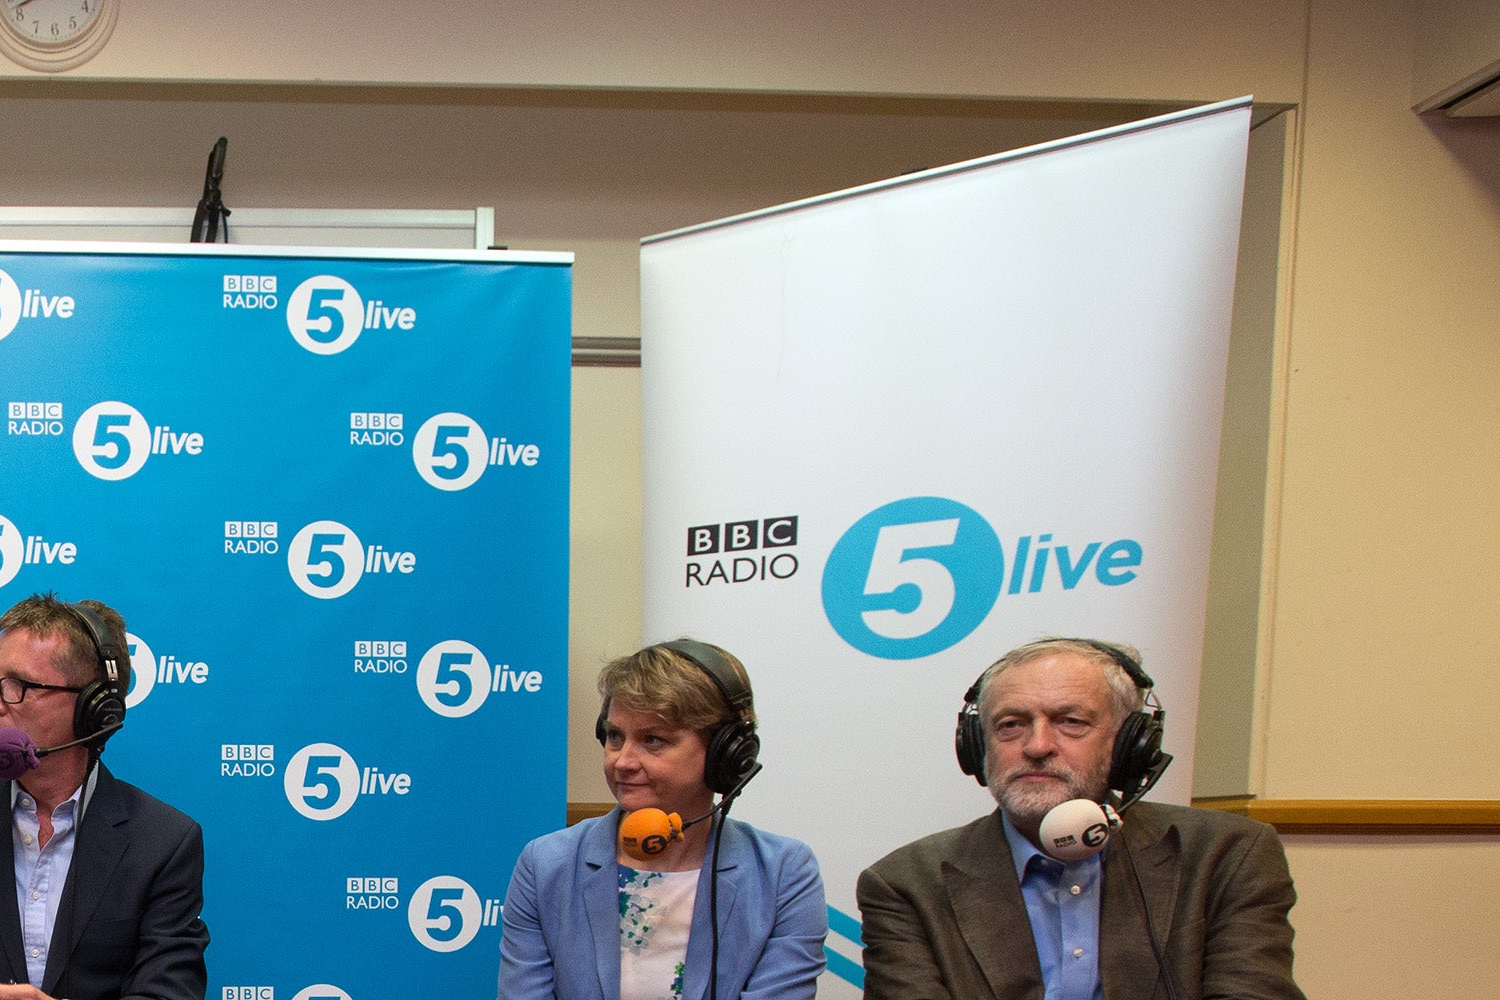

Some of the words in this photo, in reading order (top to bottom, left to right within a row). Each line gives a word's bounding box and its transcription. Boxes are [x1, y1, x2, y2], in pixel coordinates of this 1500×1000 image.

[81, 0, 89, 13] 4
[32, 20, 40, 33] 7
[51, 23, 60, 36] 6
[69, 16, 77, 30] 5
[226, 276, 276, 291] BBC
[23, 289, 74, 318] live
[222, 293, 278, 310] RADIO
[306, 288, 346, 344] 5
[365, 301, 416, 329] live
[11, 403, 61, 418] BBC
[8, 420, 64, 436] RADIO
[353, 414, 402, 428] BBC
[92, 414, 132, 470] 5
[152, 426, 203, 454] live
[350, 431, 404, 446] RADIO
[432, 425, 472, 481] 5
[490, 438, 539, 466] live
[227, 522, 276, 537] BBC
[690, 517, 796, 554] BBC
[25, 536, 77, 564] live
[224, 539, 279, 555] RADIO
[307, 534, 346, 589] 5
[366, 546, 415, 573] live
[686, 554, 799, 587] RADIO
[861, 518, 960, 639] 5
[1007, 535, 1143, 595] live
[357, 642, 405, 656] BBC
[157, 655, 209, 684] live
[354, 659, 408, 674] RADIO
[436, 653, 475, 707] 5
[493, 665, 542, 692] live
[224, 746, 273, 759] BBC
[221, 762, 275, 777] RADIO
[303, 756, 342, 810] 5
[362, 767, 411, 794] live
[349, 879, 397, 892] BBC
[346, 895, 399, 910] RADIO
[426, 889, 465, 942] 5
[483, 899, 504, 926] li
[224, 988, 272, 1000] BBC
